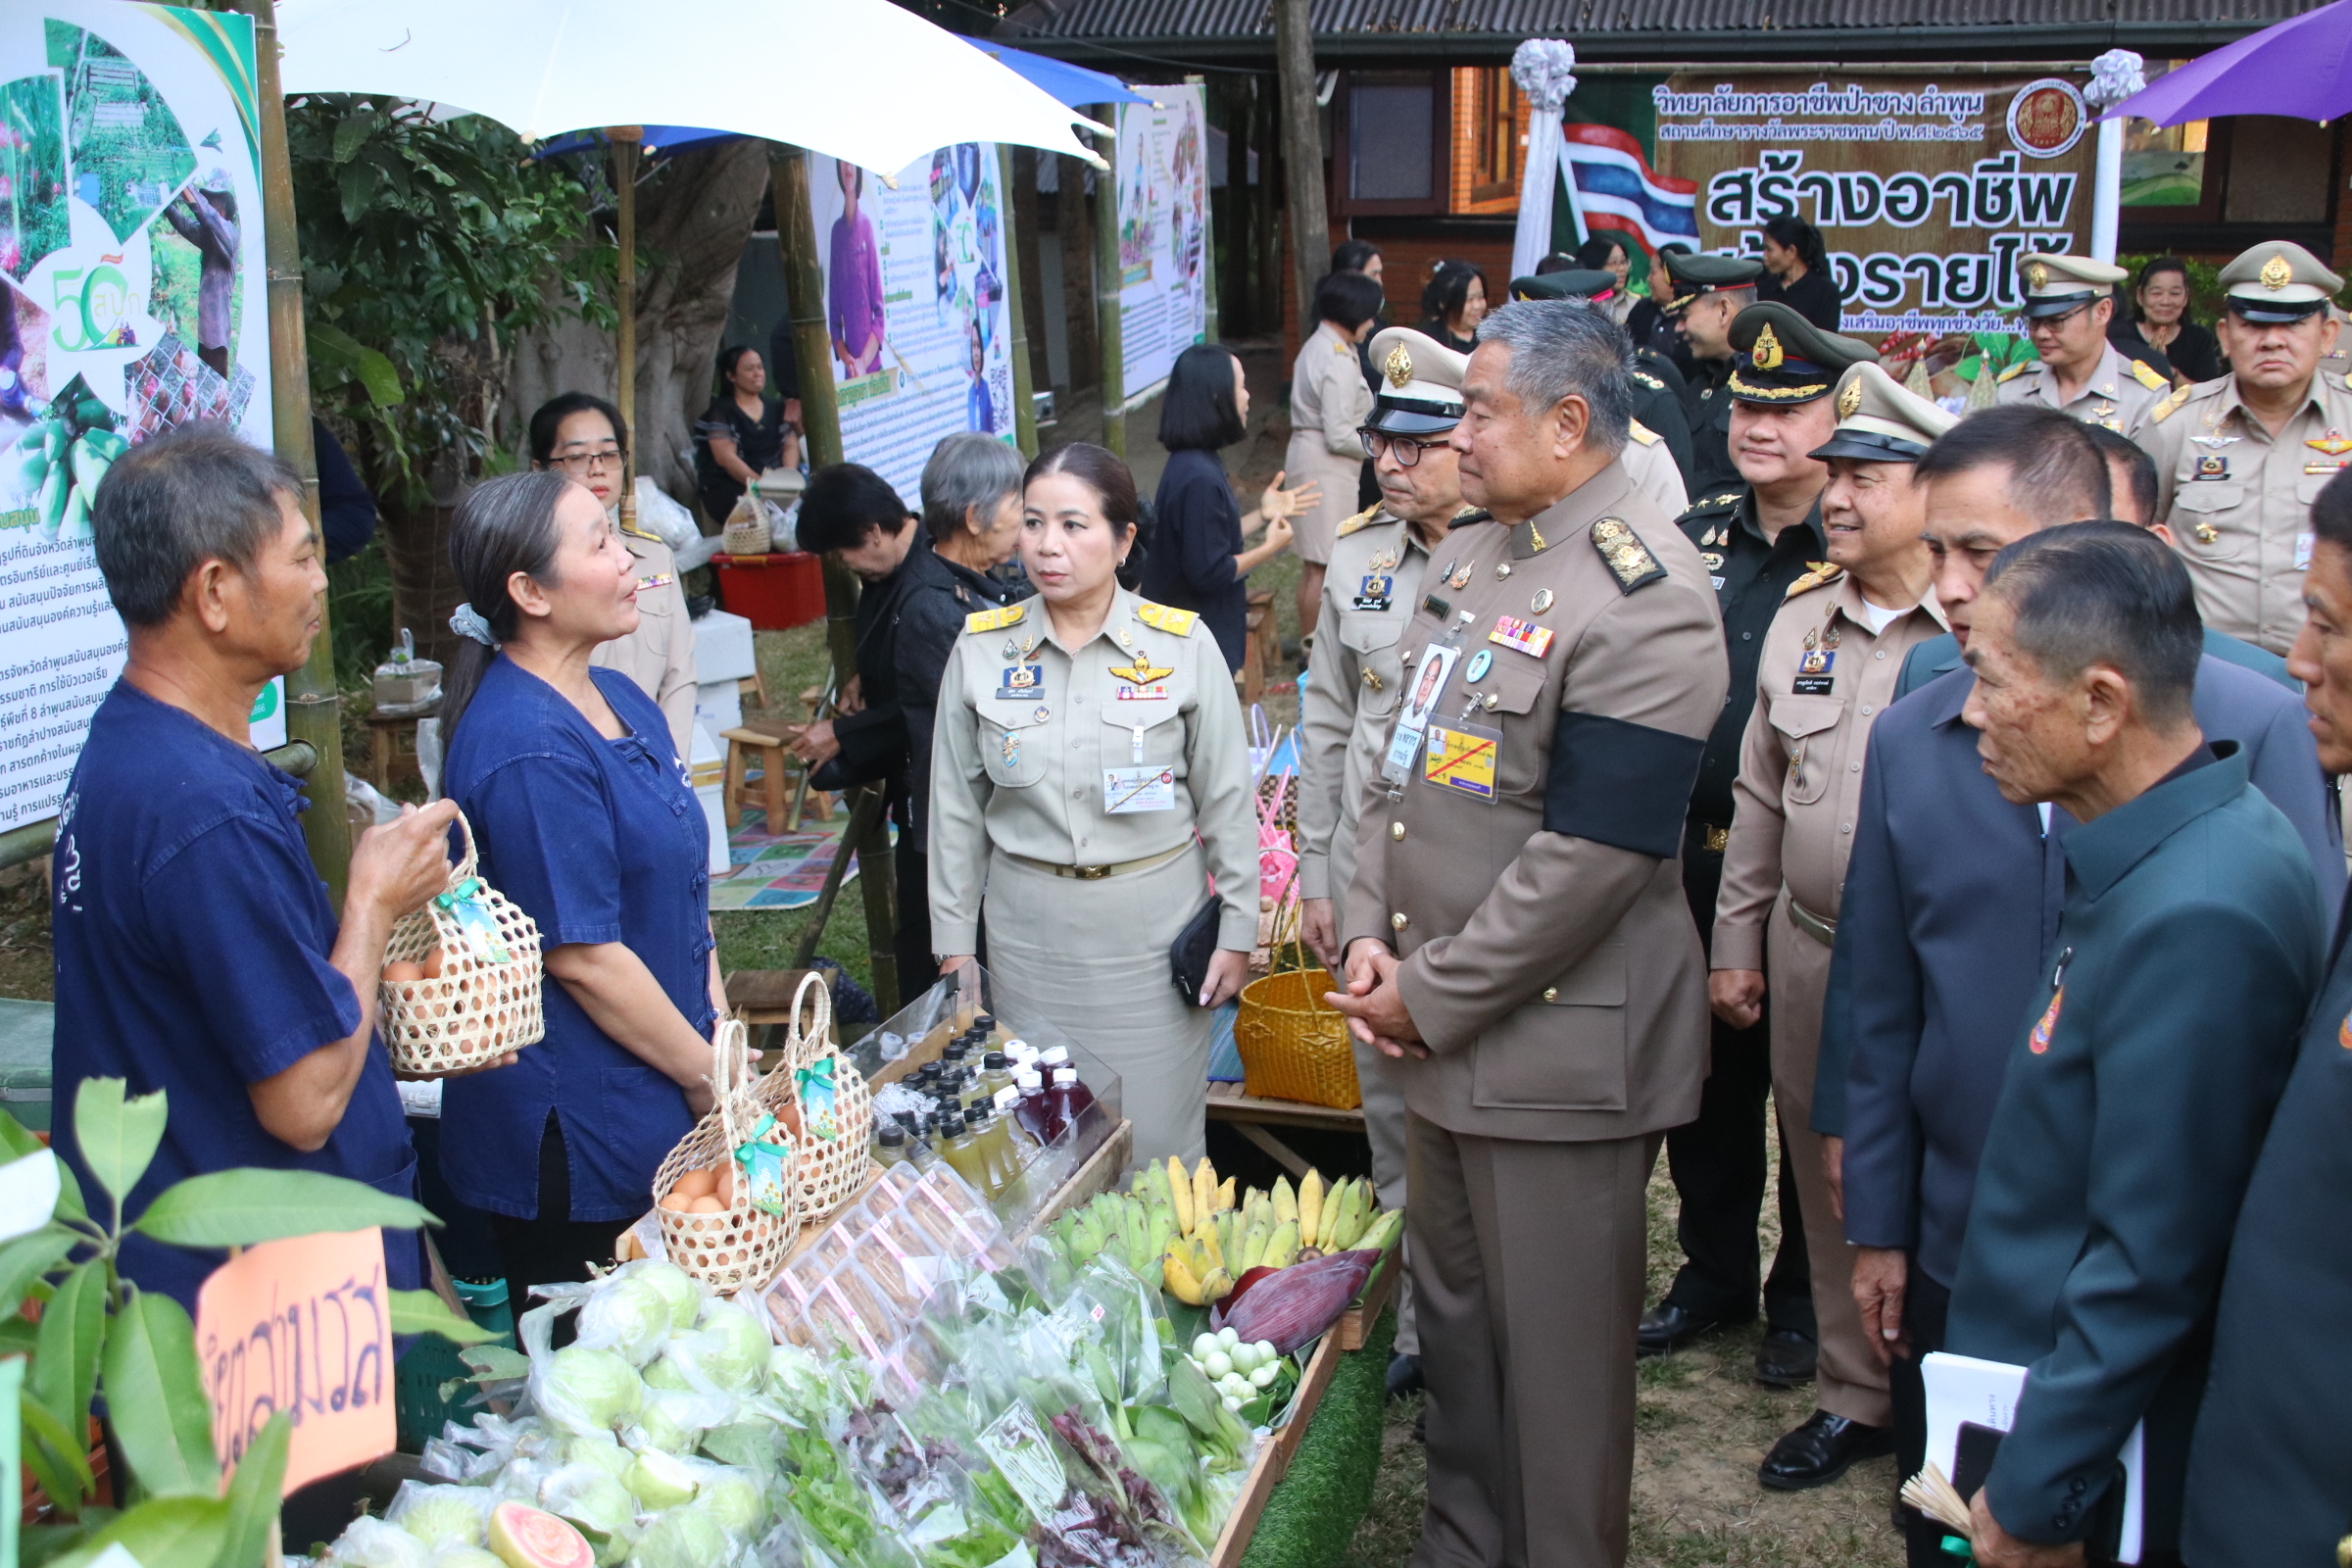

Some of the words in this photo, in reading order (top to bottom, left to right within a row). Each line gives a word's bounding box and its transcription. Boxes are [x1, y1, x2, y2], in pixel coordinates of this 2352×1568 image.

[1652, 83, 1914, 116] วิทยาลัยการอาชีพป่าซาง
[1918, 84, 1984, 123] ลำพูน
[1706, 150, 2078, 227] สร้างอาชีพ
[30, 707, 37, 720] 8
